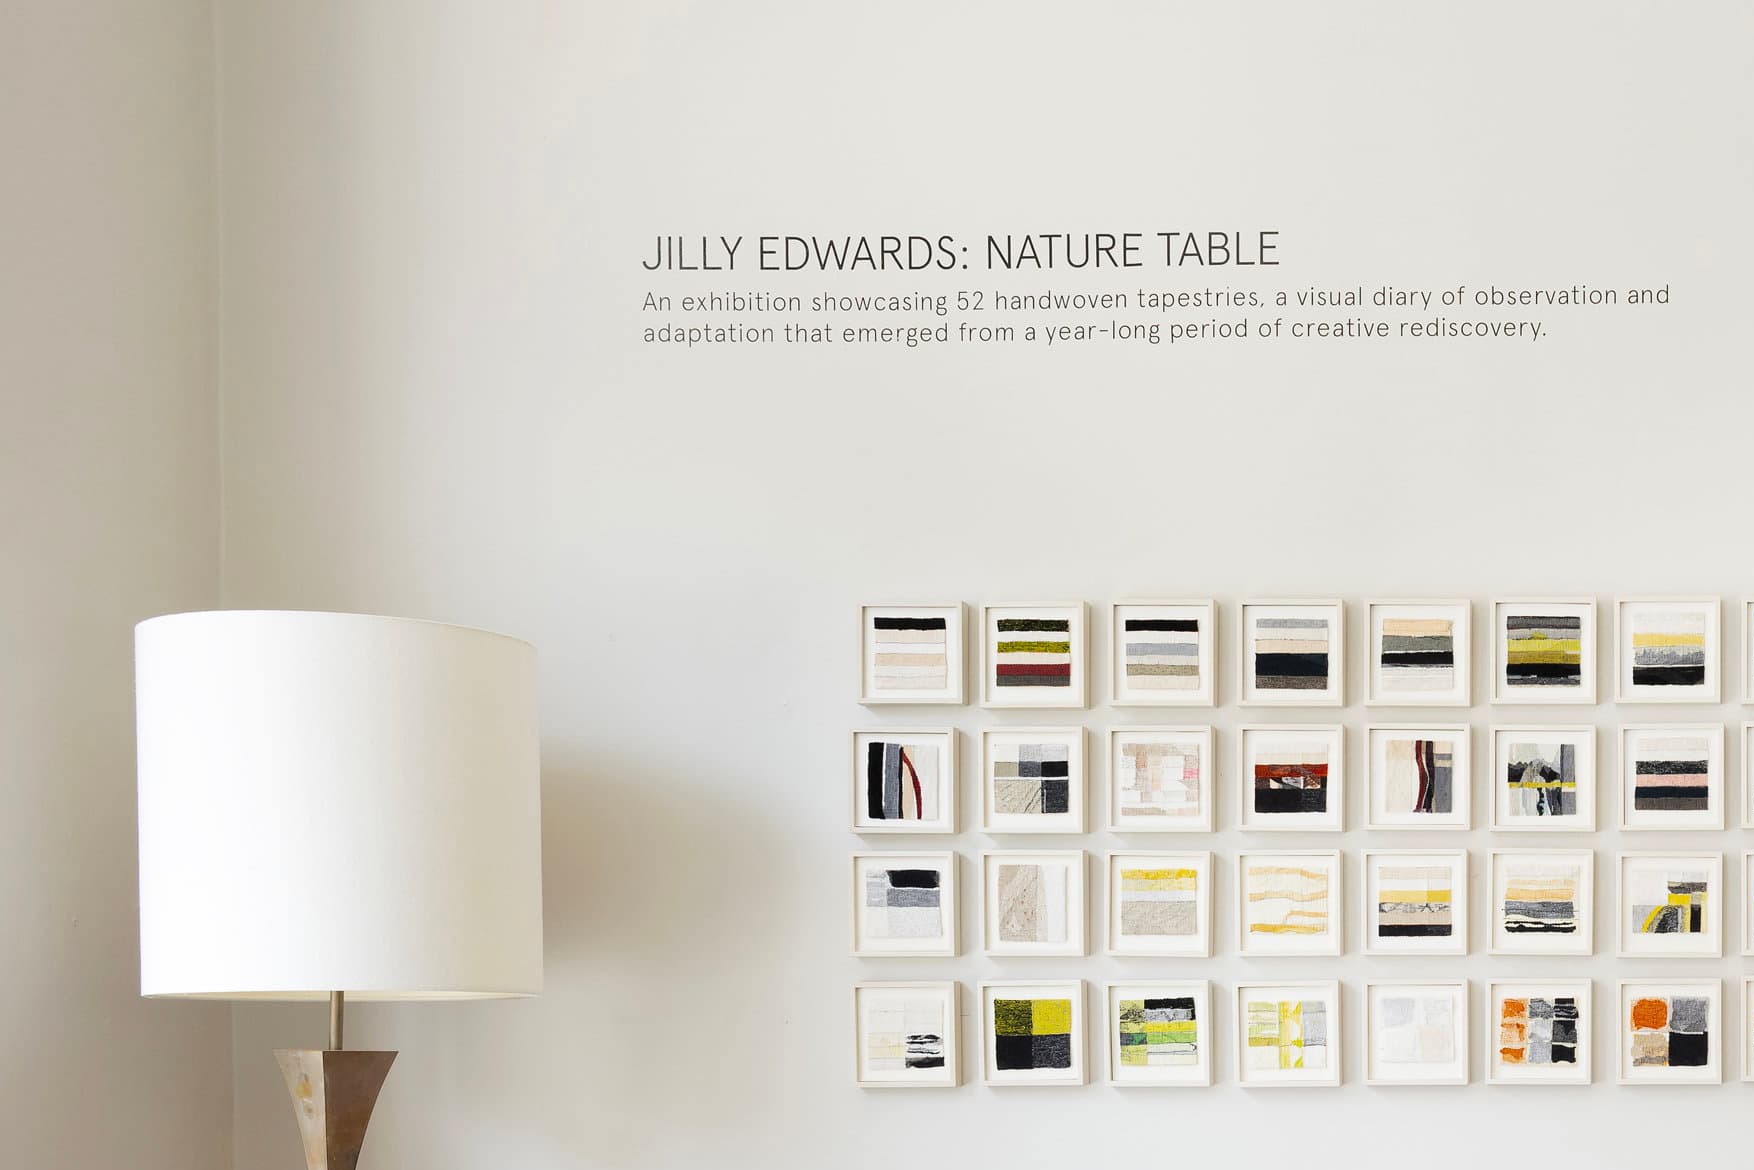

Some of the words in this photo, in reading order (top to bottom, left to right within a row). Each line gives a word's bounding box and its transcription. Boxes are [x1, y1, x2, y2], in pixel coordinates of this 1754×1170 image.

[641, 235, 744, 271] JILLY
[759, 235, 968, 271] EDWARDS:
[987, 232, 1144, 270] NATURE
[1156, 230, 1280, 267] TABLE
[642, 291, 671, 312] An
[681, 290, 801, 312] exhibition
[811, 290, 948, 317] showcasing
[956, 290, 985, 311] 52
[995, 289, 1127, 311] handwoven
[1136, 285, 1265, 313] tapestries,
[1275, 291, 1287, 307] a
[1296, 285, 1363, 307] visual
[1372, 285, 1433, 312] diary
[1441, 285, 1466, 306] of
[1474, 284, 1617, 306] observation
[1627, 283, 1670, 305] and
[643, 322, 774, 349] adaptation
[783, 322, 833, 344] that
[842, 321, 948, 348] emerged
[958, 321, 1014, 343] from
[1024, 326, 1036, 342] a
[1044, 319, 1161, 347] year-long
[1170, 317, 1248, 345] period
[1258, 317, 1283, 338] of
[1291, 317, 1390, 338] creative
[1400, 316, 1547, 343] rediscovery.
